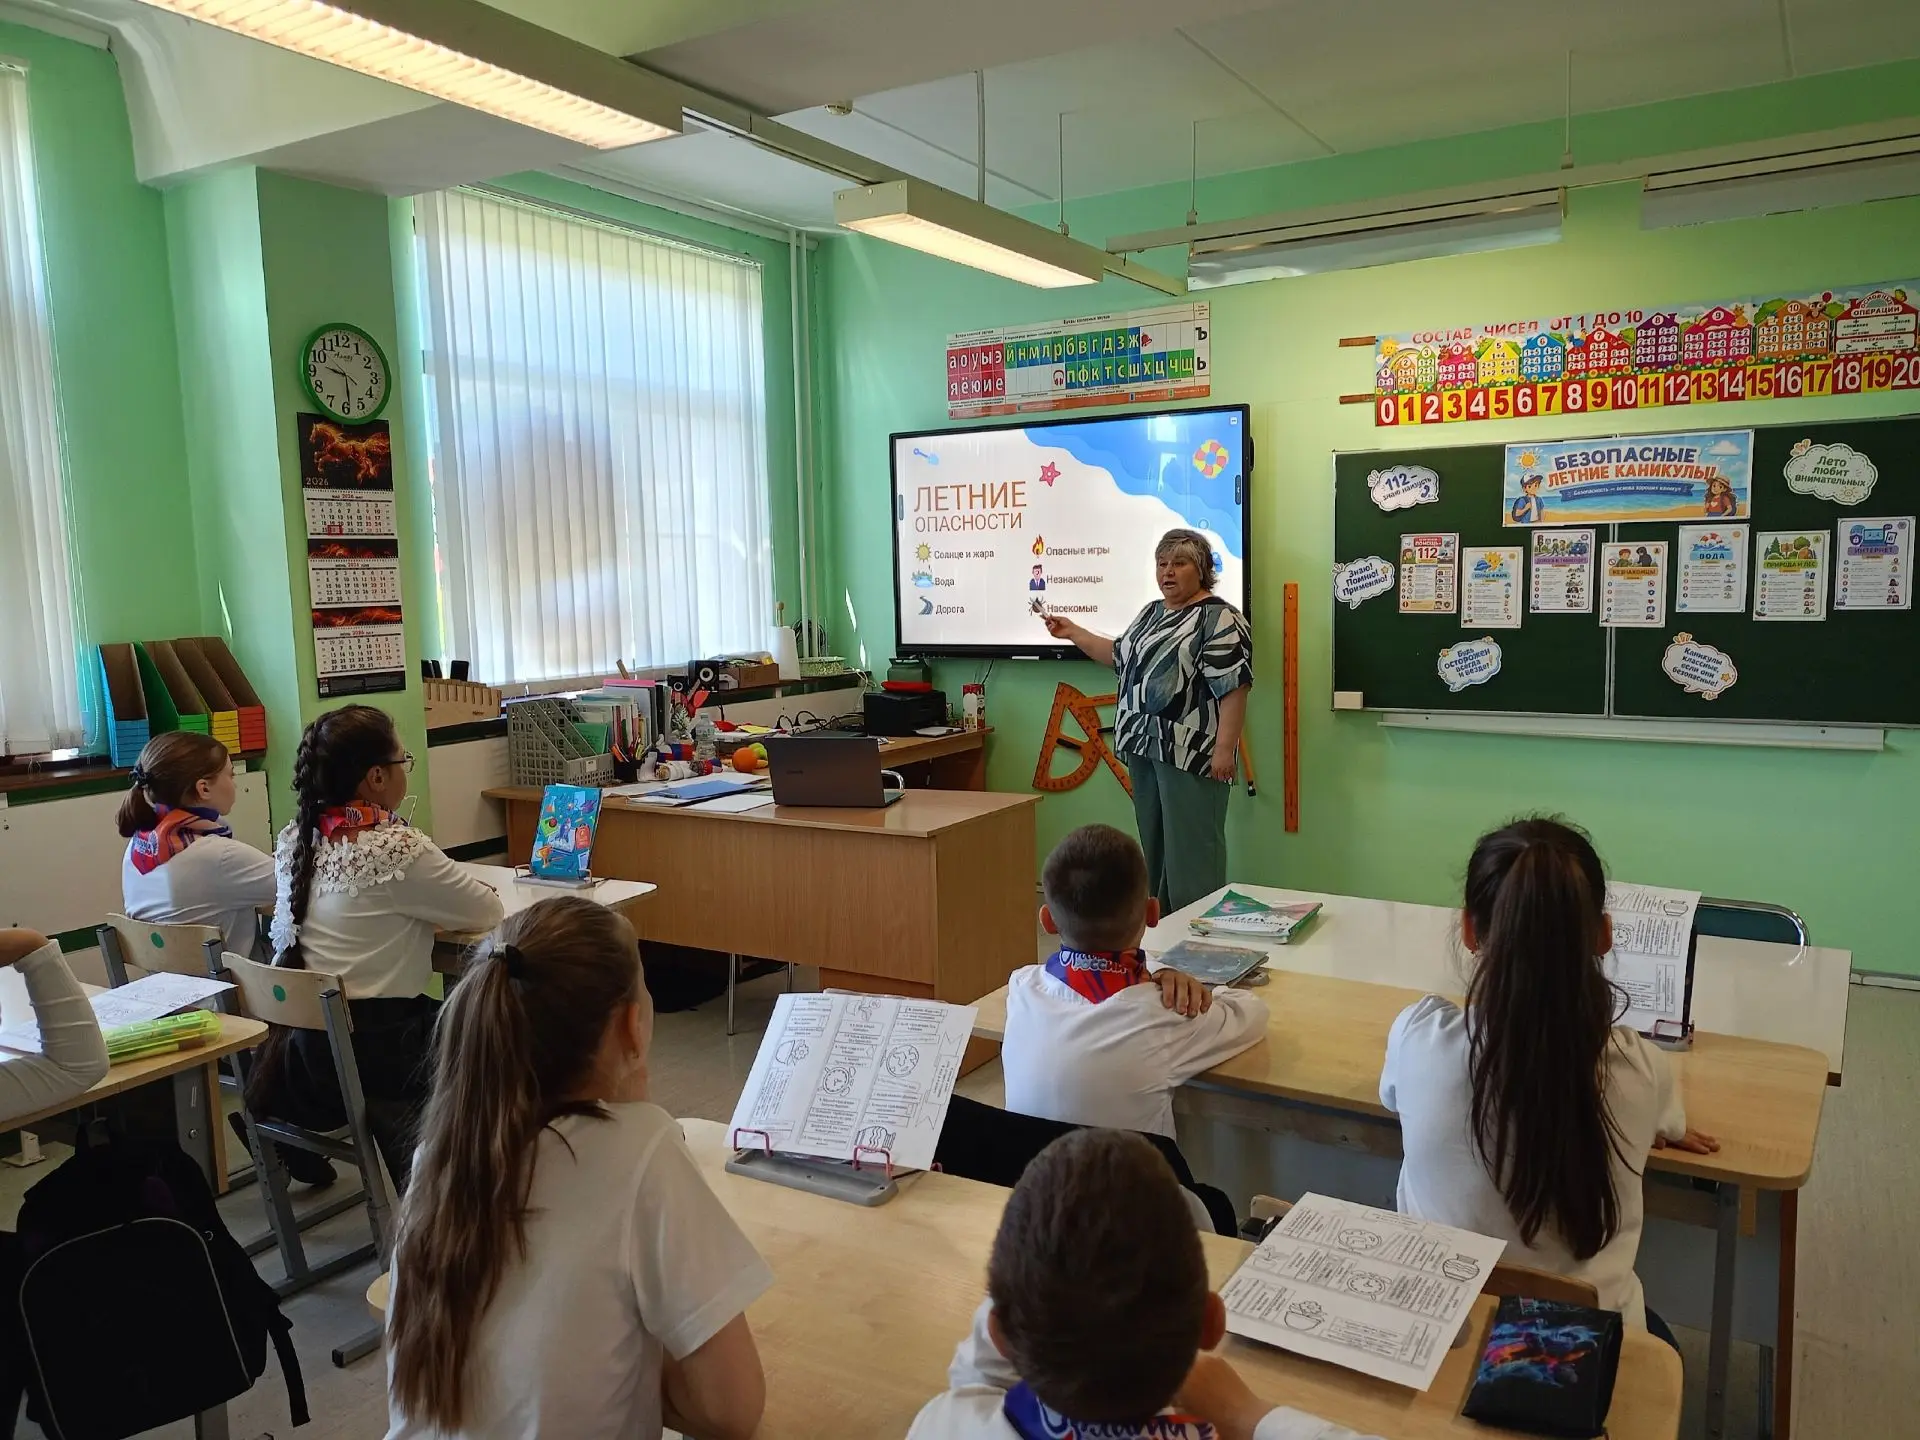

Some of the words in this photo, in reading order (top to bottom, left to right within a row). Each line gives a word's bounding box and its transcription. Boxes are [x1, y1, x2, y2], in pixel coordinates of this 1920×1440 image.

[1789, 304, 1798, 312] 10
[1853, 306, 1900, 316] ОПЕРАЦИИ
[1485, 321, 1538, 336] ЧИСЕЛ
[1551, 317, 1572, 330] ОТ
[1577, 316, 1585, 327] 1
[1592, 312, 1620, 328] ДО
[1625, 310, 1643, 323] 10
[320, 337, 335, 352] 11
[334, 334, 350, 348] 12
[353, 343, 361, 355] 1
[950, 356, 956, 368] а
[961, 355, 967, 367] о
[972, 352, 978, 370] у
[982, 352, 991, 365] ы
[995, 351, 1002, 363] э
[1007, 345, 1013, 361] й
[1019, 348, 1026, 360] н
[1029, 346, 1039, 359] м
[1043, 344, 1050, 357] л
[1054, 343, 1062, 361] р
[1066, 338, 1074, 355] б
[1078, 340, 1086, 354] в
[1092, 339, 1098, 353] г
[1103, 337, 1113, 354] д
[1117, 336, 1125, 349] з
[1129, 334, 1139, 348] ж
[312, 349, 326, 363] 10
[363, 356, 372, 369] 2
[309, 364, 316, 377] 9
[951, 383, 957, 395] я
[961, 377, 968, 394] ё
[971, 380, 980, 393] ю
[984, 379, 991, 392] и
[996, 377, 1003, 390] е
[1067, 370, 1075, 383] п
[1078, 365, 1089, 386] ф
[1091, 367, 1099, 381] к
[1105, 366, 1112, 379] т
[1118, 365, 1125, 378] с
[1129, 363, 1139, 377] ш
[1143, 362, 1151, 375] х
[1156, 360, 1165, 378] ц
[1169, 359, 1178, 372] ч
[1182, 357, 1193, 374] щ
[370, 372, 378, 384] 3
[314, 380, 323, 393] 8
[365, 386, 374, 398] 4
[1381, 398, 1394, 423] 0
[1404, 397, 1414, 421] 1
[1425, 395, 1439, 420] 2
[1448, 393, 1462, 419] 3
[1470, 391, 1486, 416] 4
[1494, 390, 1509, 415] 5
[1517, 388, 1532, 413] 6
[1542, 386, 1557, 411] 7
[1567, 384, 1582, 410] 8
[1591, 381, 1608, 407] 9
[1612, 379, 1636, 405] 10
[1640, 377, 1660, 404] 11
[1665, 375, 1690, 402] 12
[1692, 372, 1717, 400] 13
[1720, 370, 1745, 397] 14
[1747, 368, 1773, 396] 15
[1776, 365, 1801, 394] 16
[1804, 364, 1832, 392] 17
[1834, 361, 1860, 390] 18
[1863, 358, 1892, 388] 19
[1892, 356, 1920, 386] 20
[326, 395, 335, 408] 7
[357, 397, 365, 410] 5
[342, 402, 350, 415] 6
[1554, 447, 1697, 471] БЕЗОПАСНЫЕ
[1817, 456, 1847, 467] Лето
[1548, 465, 1609, 487] ЛЕТНИЕ
[1812, 467, 1849, 477] любит
[306, 477, 329, 486] 2026
[1385, 473, 1410, 490] 112
[1795, 475, 1866, 486] внимательных
[1383, 490, 1401, 500] знаю
[1402, 477, 1432, 494] наизусть
[914, 480, 1027, 512] ЛЕТНИЕ
[915, 512, 1022, 533] ОПАСНОСТИ
[934, 550, 964, 560] Солнце
[973, 550, 995, 560] жара
[1046, 546, 1085, 556] Опасные
[1087, 546, 1110, 555] игры
[1418, 547, 1438, 558] 112
[1348, 563, 1373, 578] Знаю!
[935, 578, 955, 587] Вода
[1047, 575, 1104, 584] Незнакомцы
[1346, 569, 1379, 587] Помню!
[1342, 575, 1388, 596] Применяю!
[936, 605, 964, 615] Дорога
[1047, 604, 1098, 613] Насекомые
[1445, 648, 1490, 669] осторожен
[1685, 648, 1722, 665] Каникулы
[1456, 660, 1480, 672] всегда
[1465, 663, 1489, 675] везде!
[1681, 664, 1699, 673] если
[1701, 670, 1714, 678] они
[1682, 656, 1719, 673] классные,
[1672, 667, 1719, 687] безопасные!
